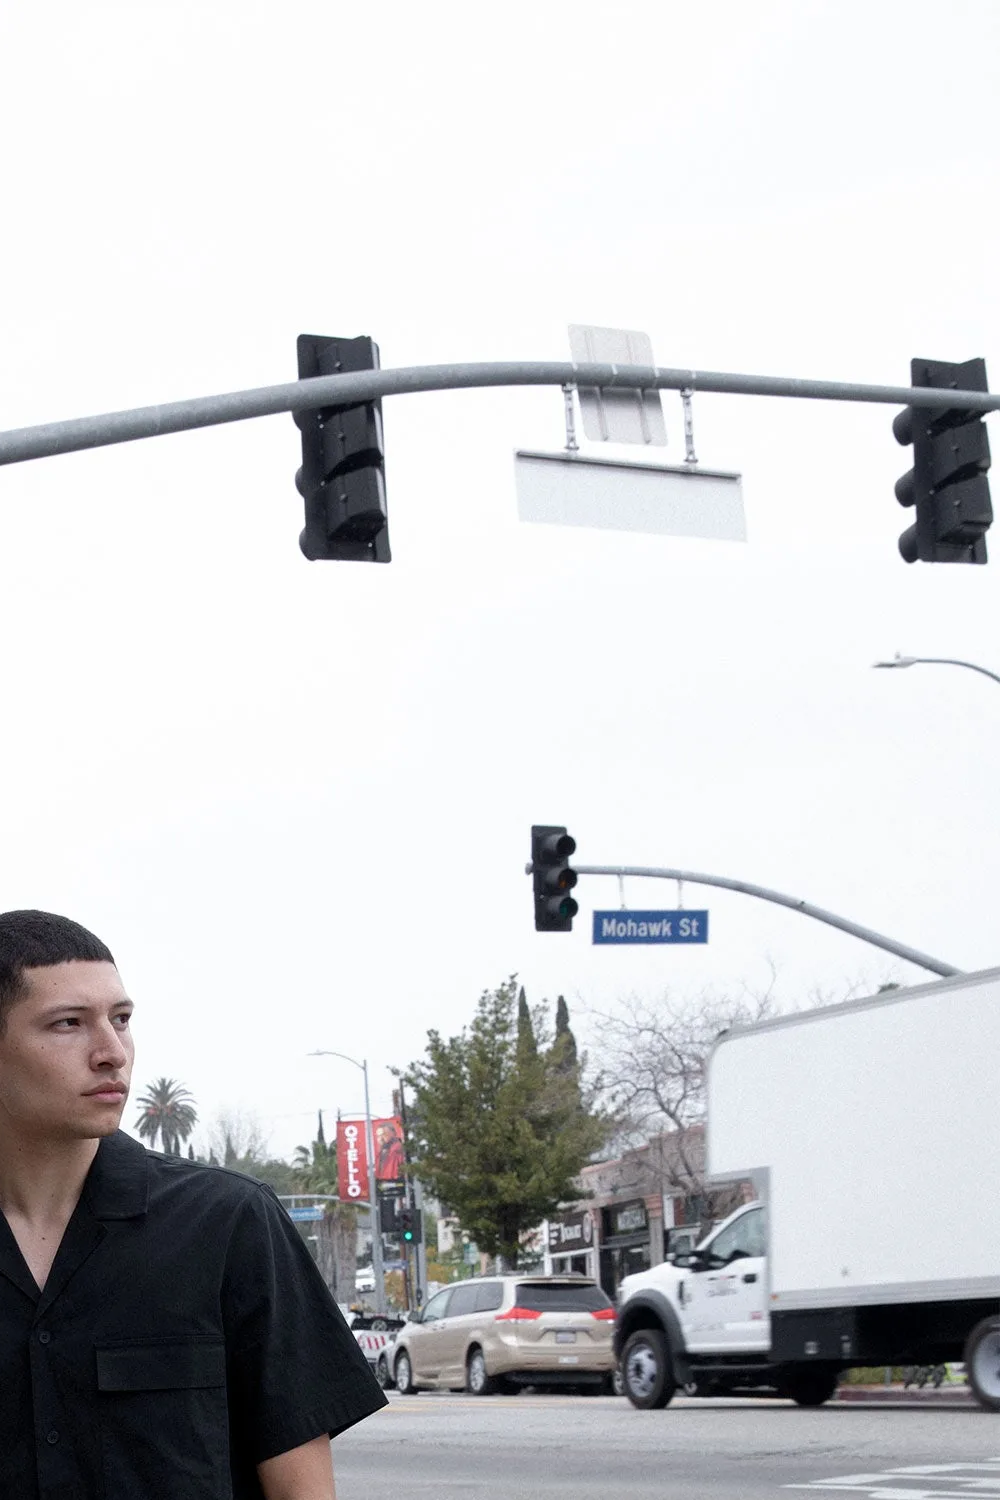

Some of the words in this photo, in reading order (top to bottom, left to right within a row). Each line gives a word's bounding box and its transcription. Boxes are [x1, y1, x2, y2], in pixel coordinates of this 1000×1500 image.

[602, 918, 672, 937] Mohawk
[679, 918, 699, 937] St
[344, 1125, 361, 1198] OTELLO
